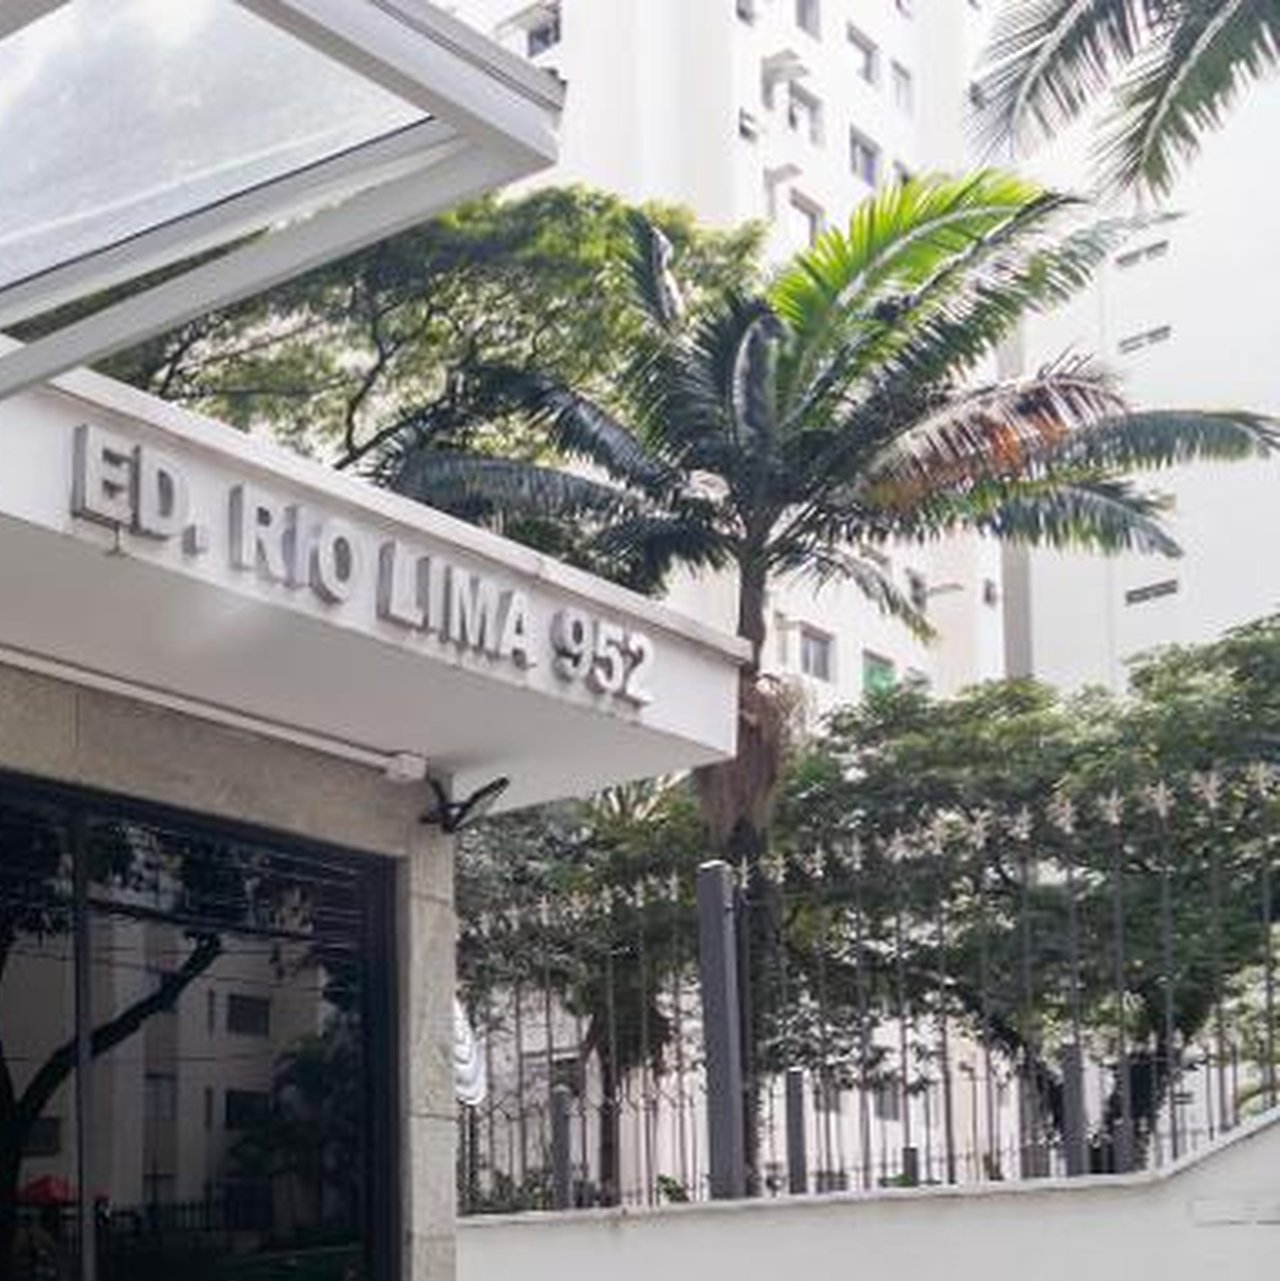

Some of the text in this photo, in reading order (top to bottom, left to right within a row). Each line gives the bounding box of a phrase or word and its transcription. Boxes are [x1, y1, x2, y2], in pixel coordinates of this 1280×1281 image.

[72, 422, 656, 707] ED. RIO LIMA 952
